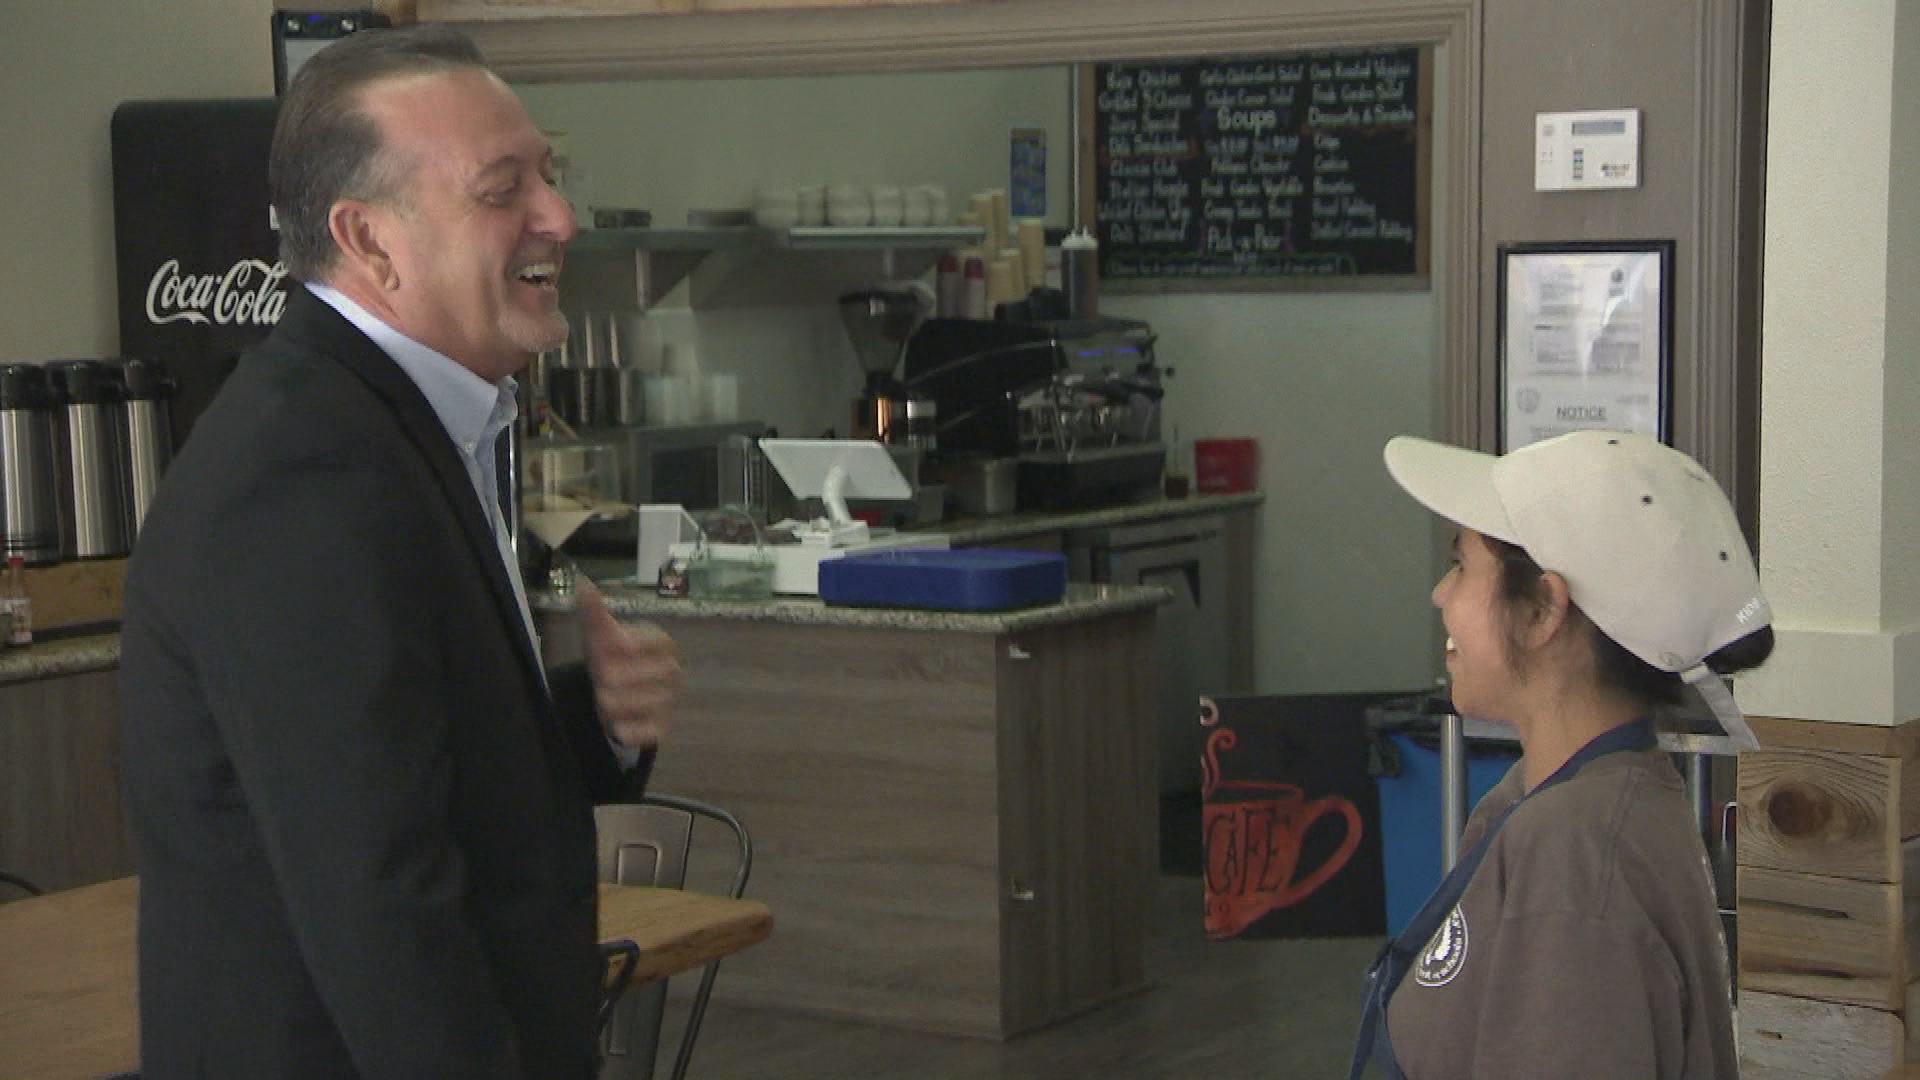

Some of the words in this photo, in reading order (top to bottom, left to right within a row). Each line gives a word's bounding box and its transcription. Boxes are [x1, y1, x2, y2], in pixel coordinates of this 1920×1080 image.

[1217, 106, 1278, 137] Soups
[146, 259, 289, 325] Coca-Cola
[1556, 406, 1605, 420] NOTICE
